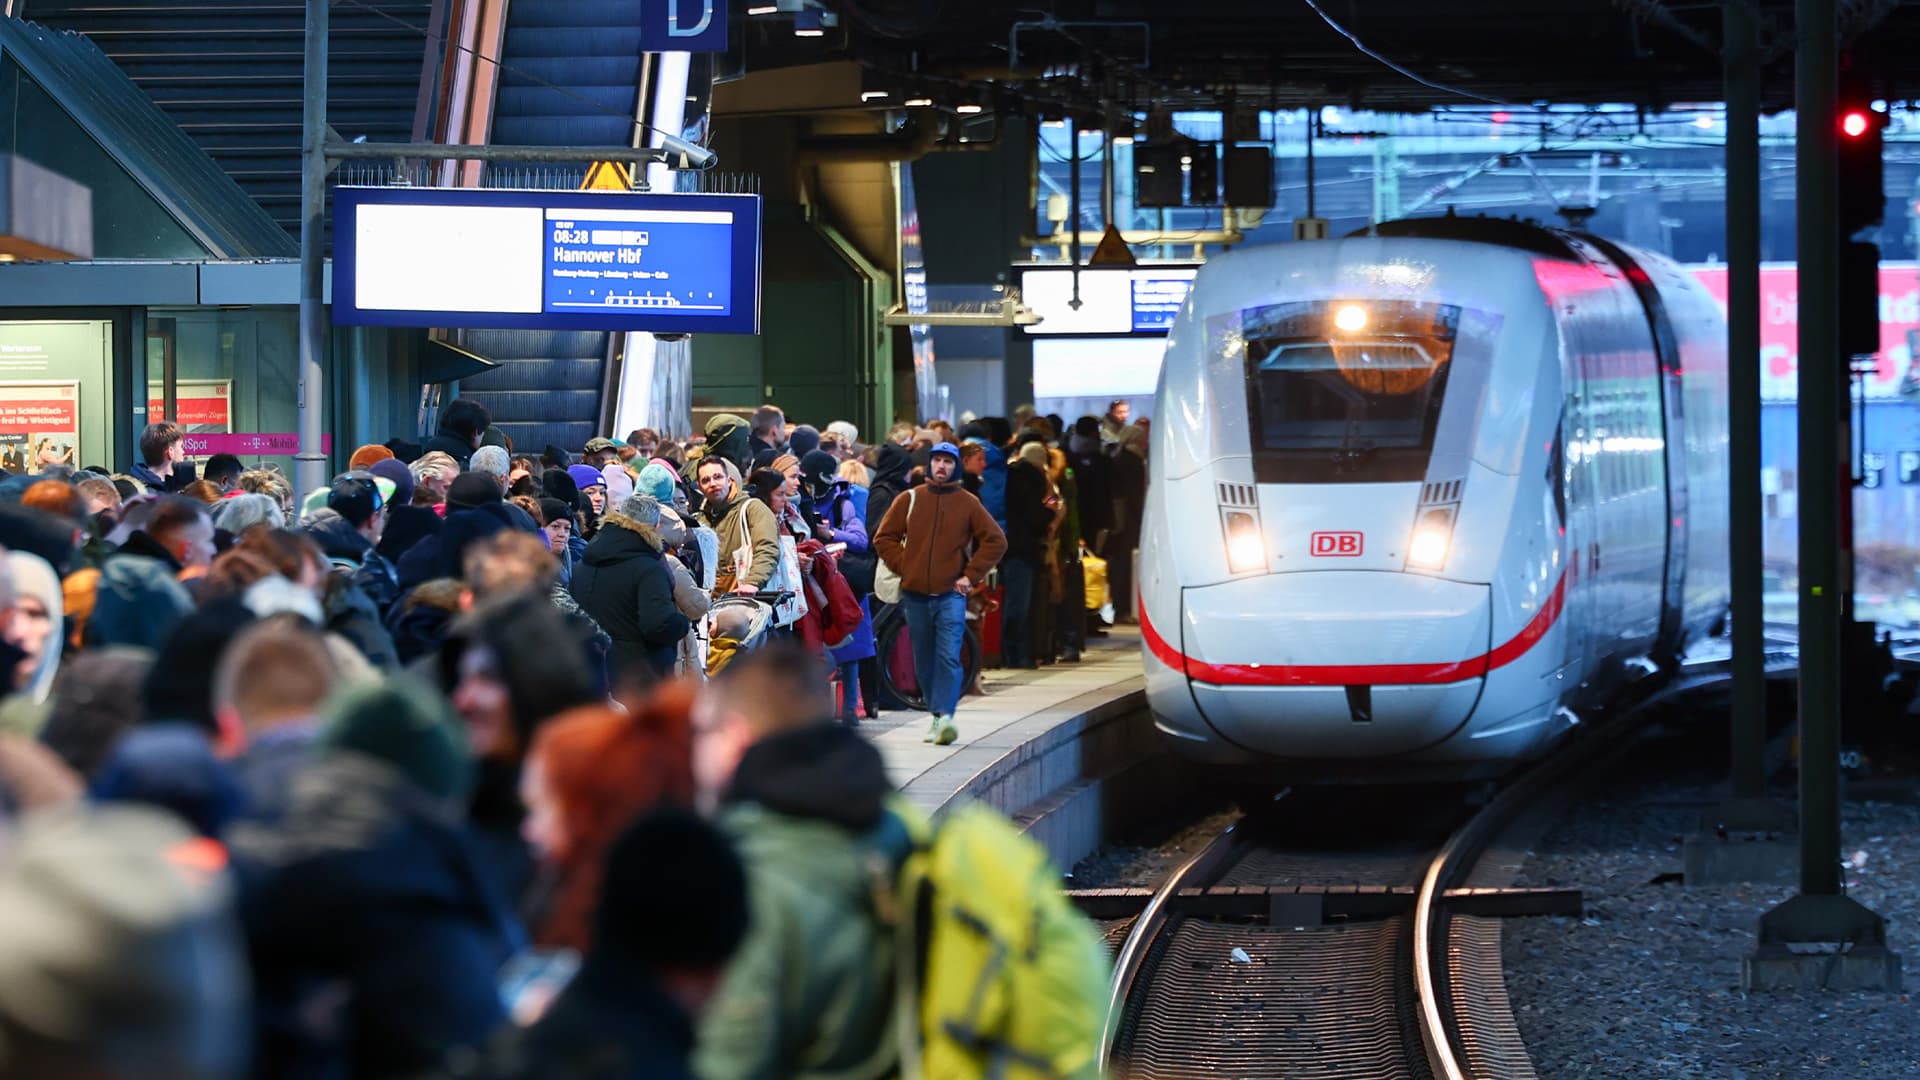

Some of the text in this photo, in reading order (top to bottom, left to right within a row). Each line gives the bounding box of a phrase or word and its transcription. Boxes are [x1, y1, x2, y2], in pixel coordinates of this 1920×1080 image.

[668, 0, 713, 37] D
[553, 230, 589, 244] 08:28
[553, 246, 642, 264] Hannover Hbf
[1316, 534, 1358, 554] DB
